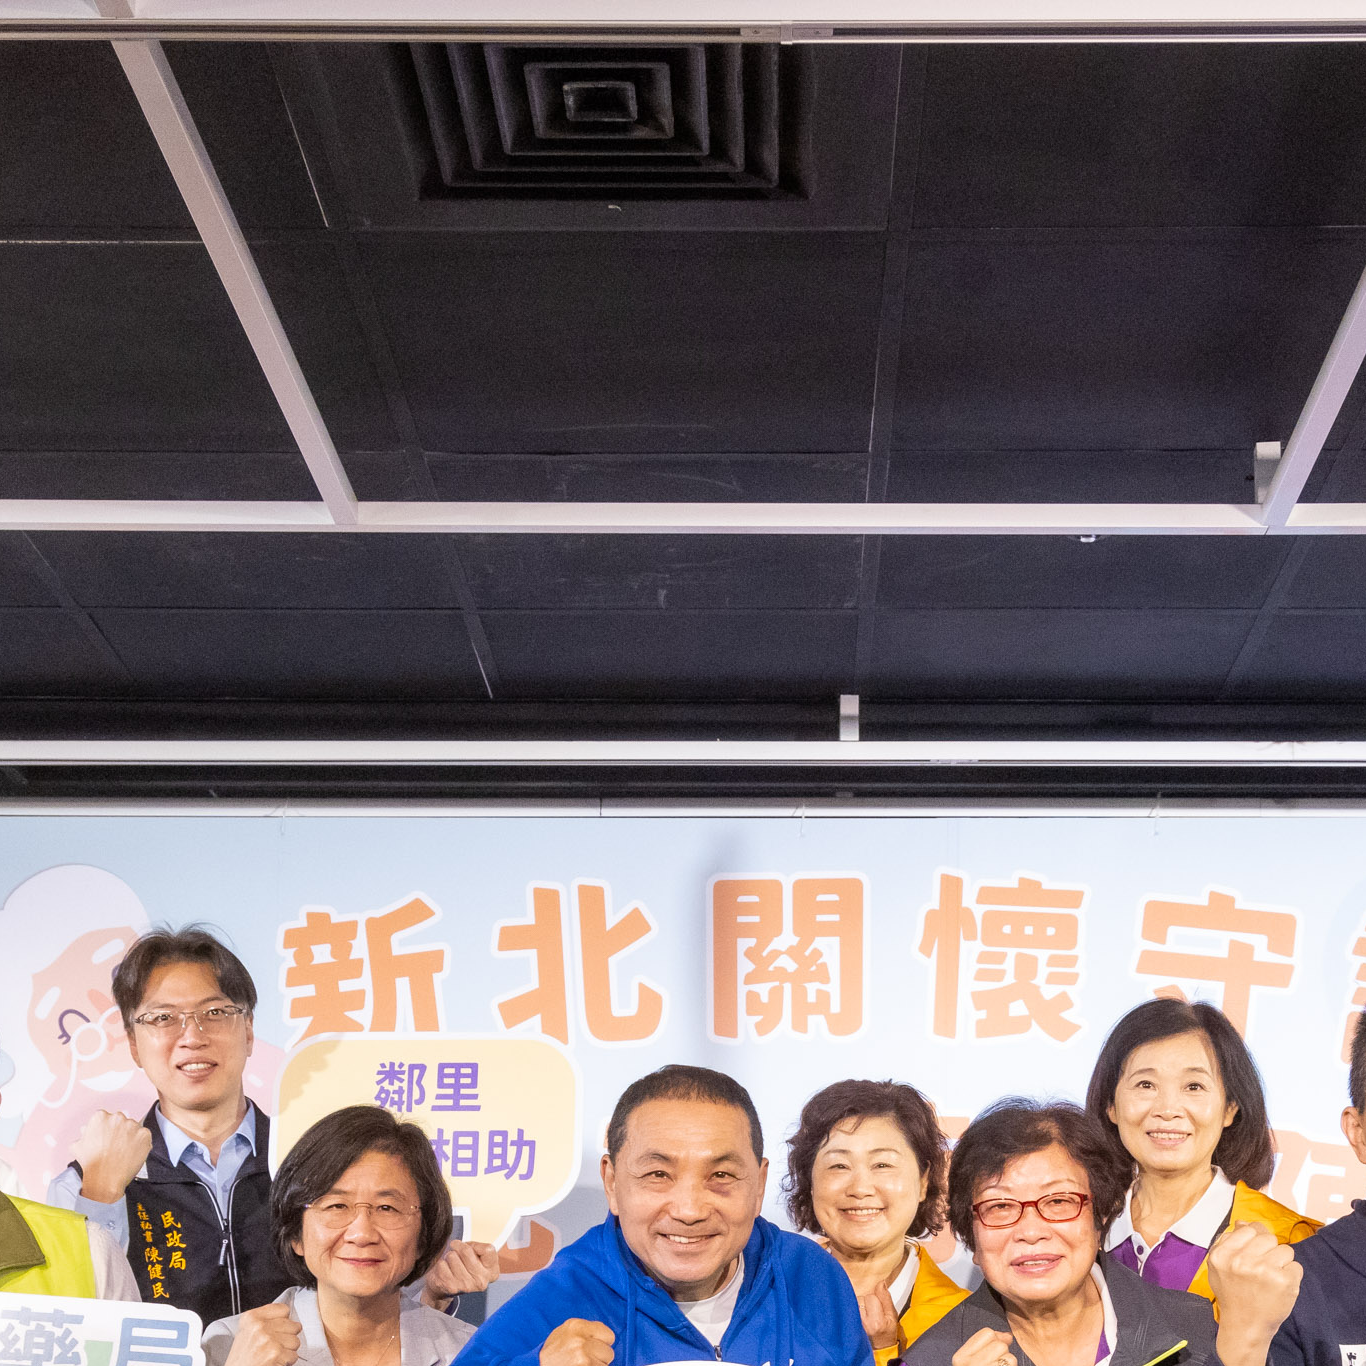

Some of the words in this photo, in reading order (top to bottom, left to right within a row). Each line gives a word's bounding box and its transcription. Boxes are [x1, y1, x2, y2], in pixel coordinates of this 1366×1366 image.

[374, 1061, 482, 1112] 鄰里
[430, 1128, 536, 1180] 相助
[161, 1211, 187, 1270] 民政局
[145, 1246, 170, 1298] 陳健民
